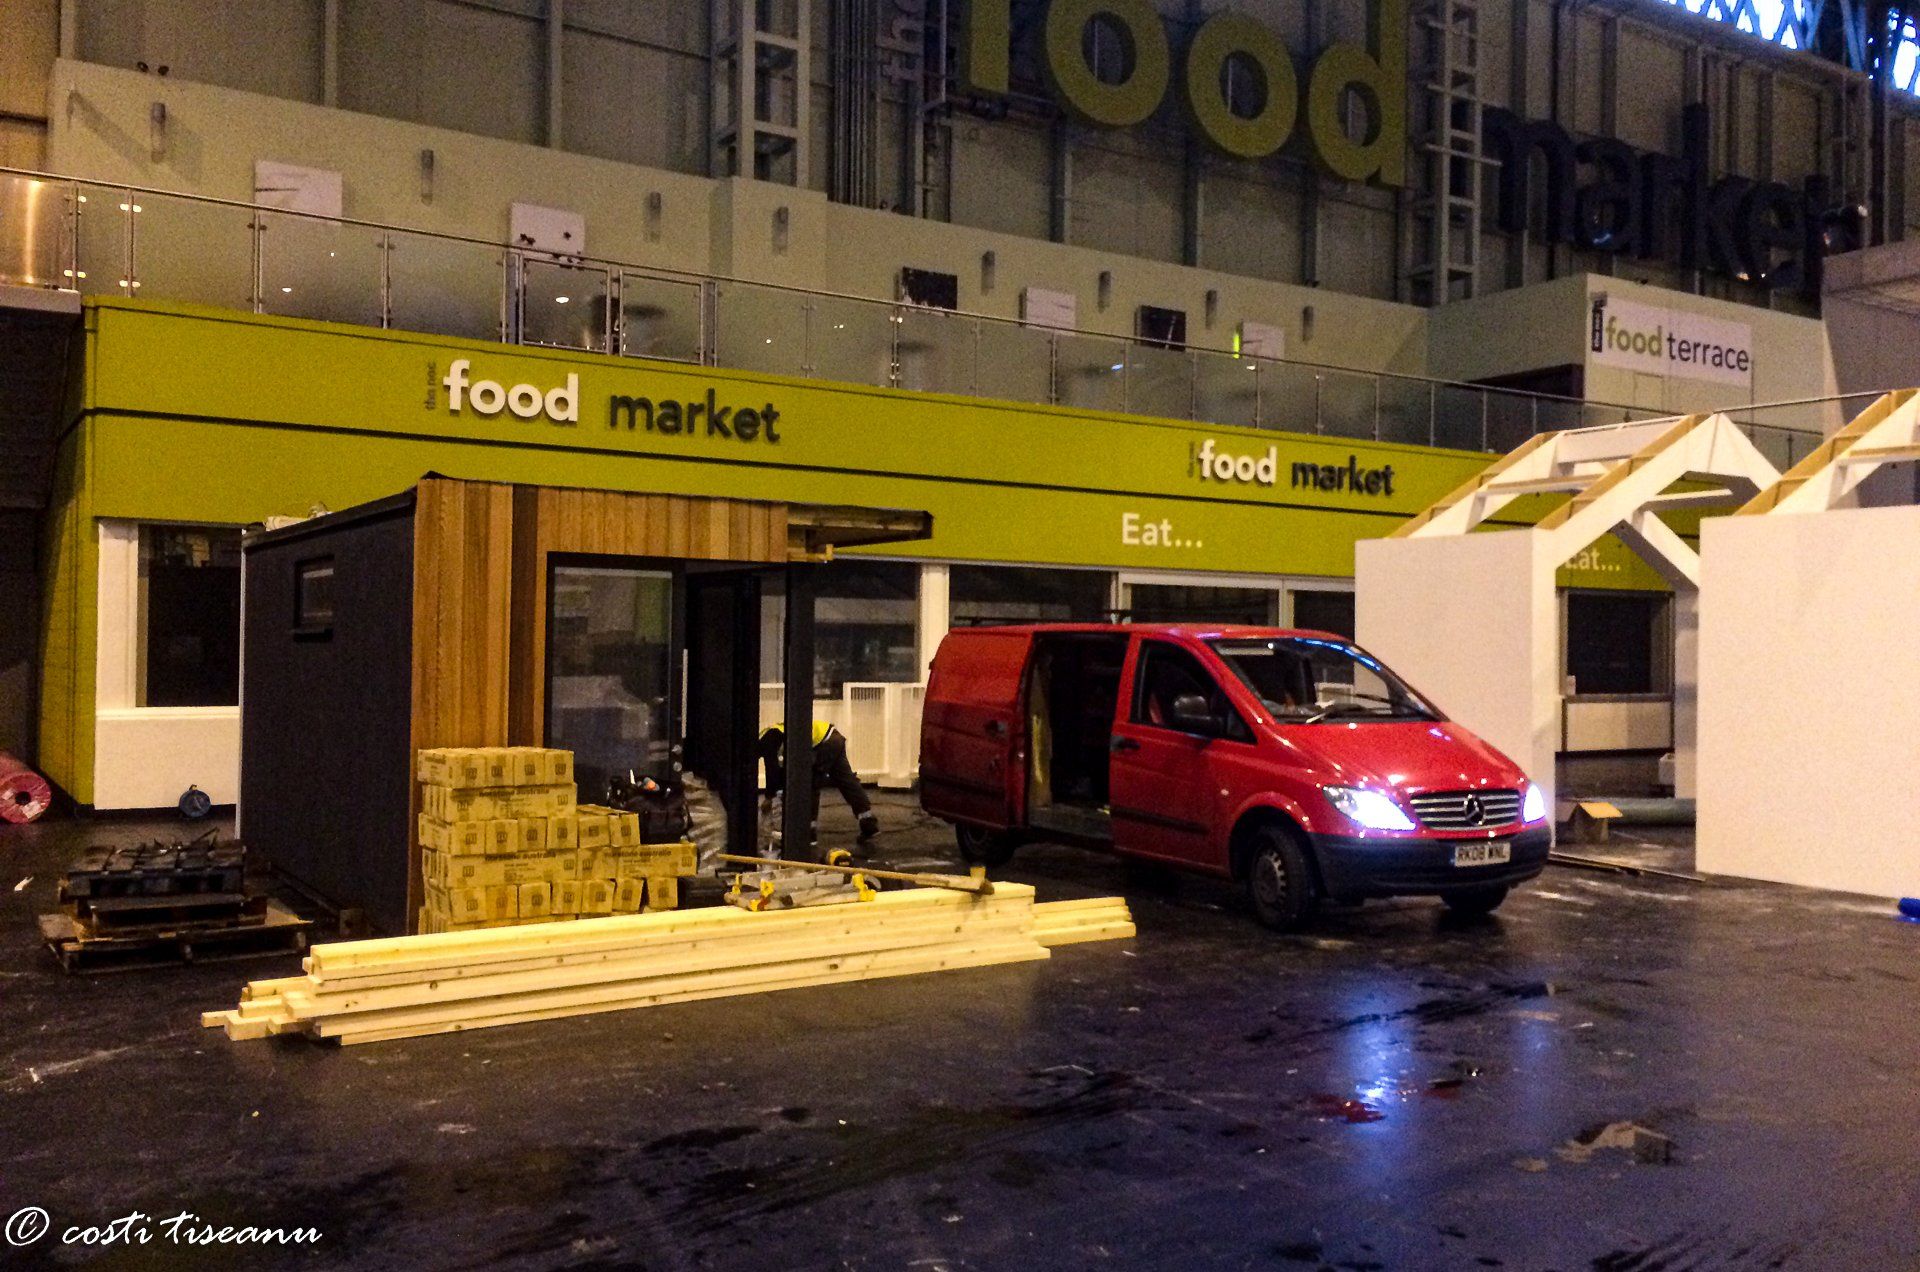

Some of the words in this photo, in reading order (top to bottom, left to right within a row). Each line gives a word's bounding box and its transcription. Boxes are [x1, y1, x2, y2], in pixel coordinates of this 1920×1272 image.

[1606, 316, 1663, 357] food
[1667, 332, 1750, 372] terrace
[443, 359, 579, 422] food
[609, 388, 781, 443] market
[1198, 439, 1277, 485] food
[1291, 454, 1395, 496] market
[1121, 513, 1203, 548] Eat...
